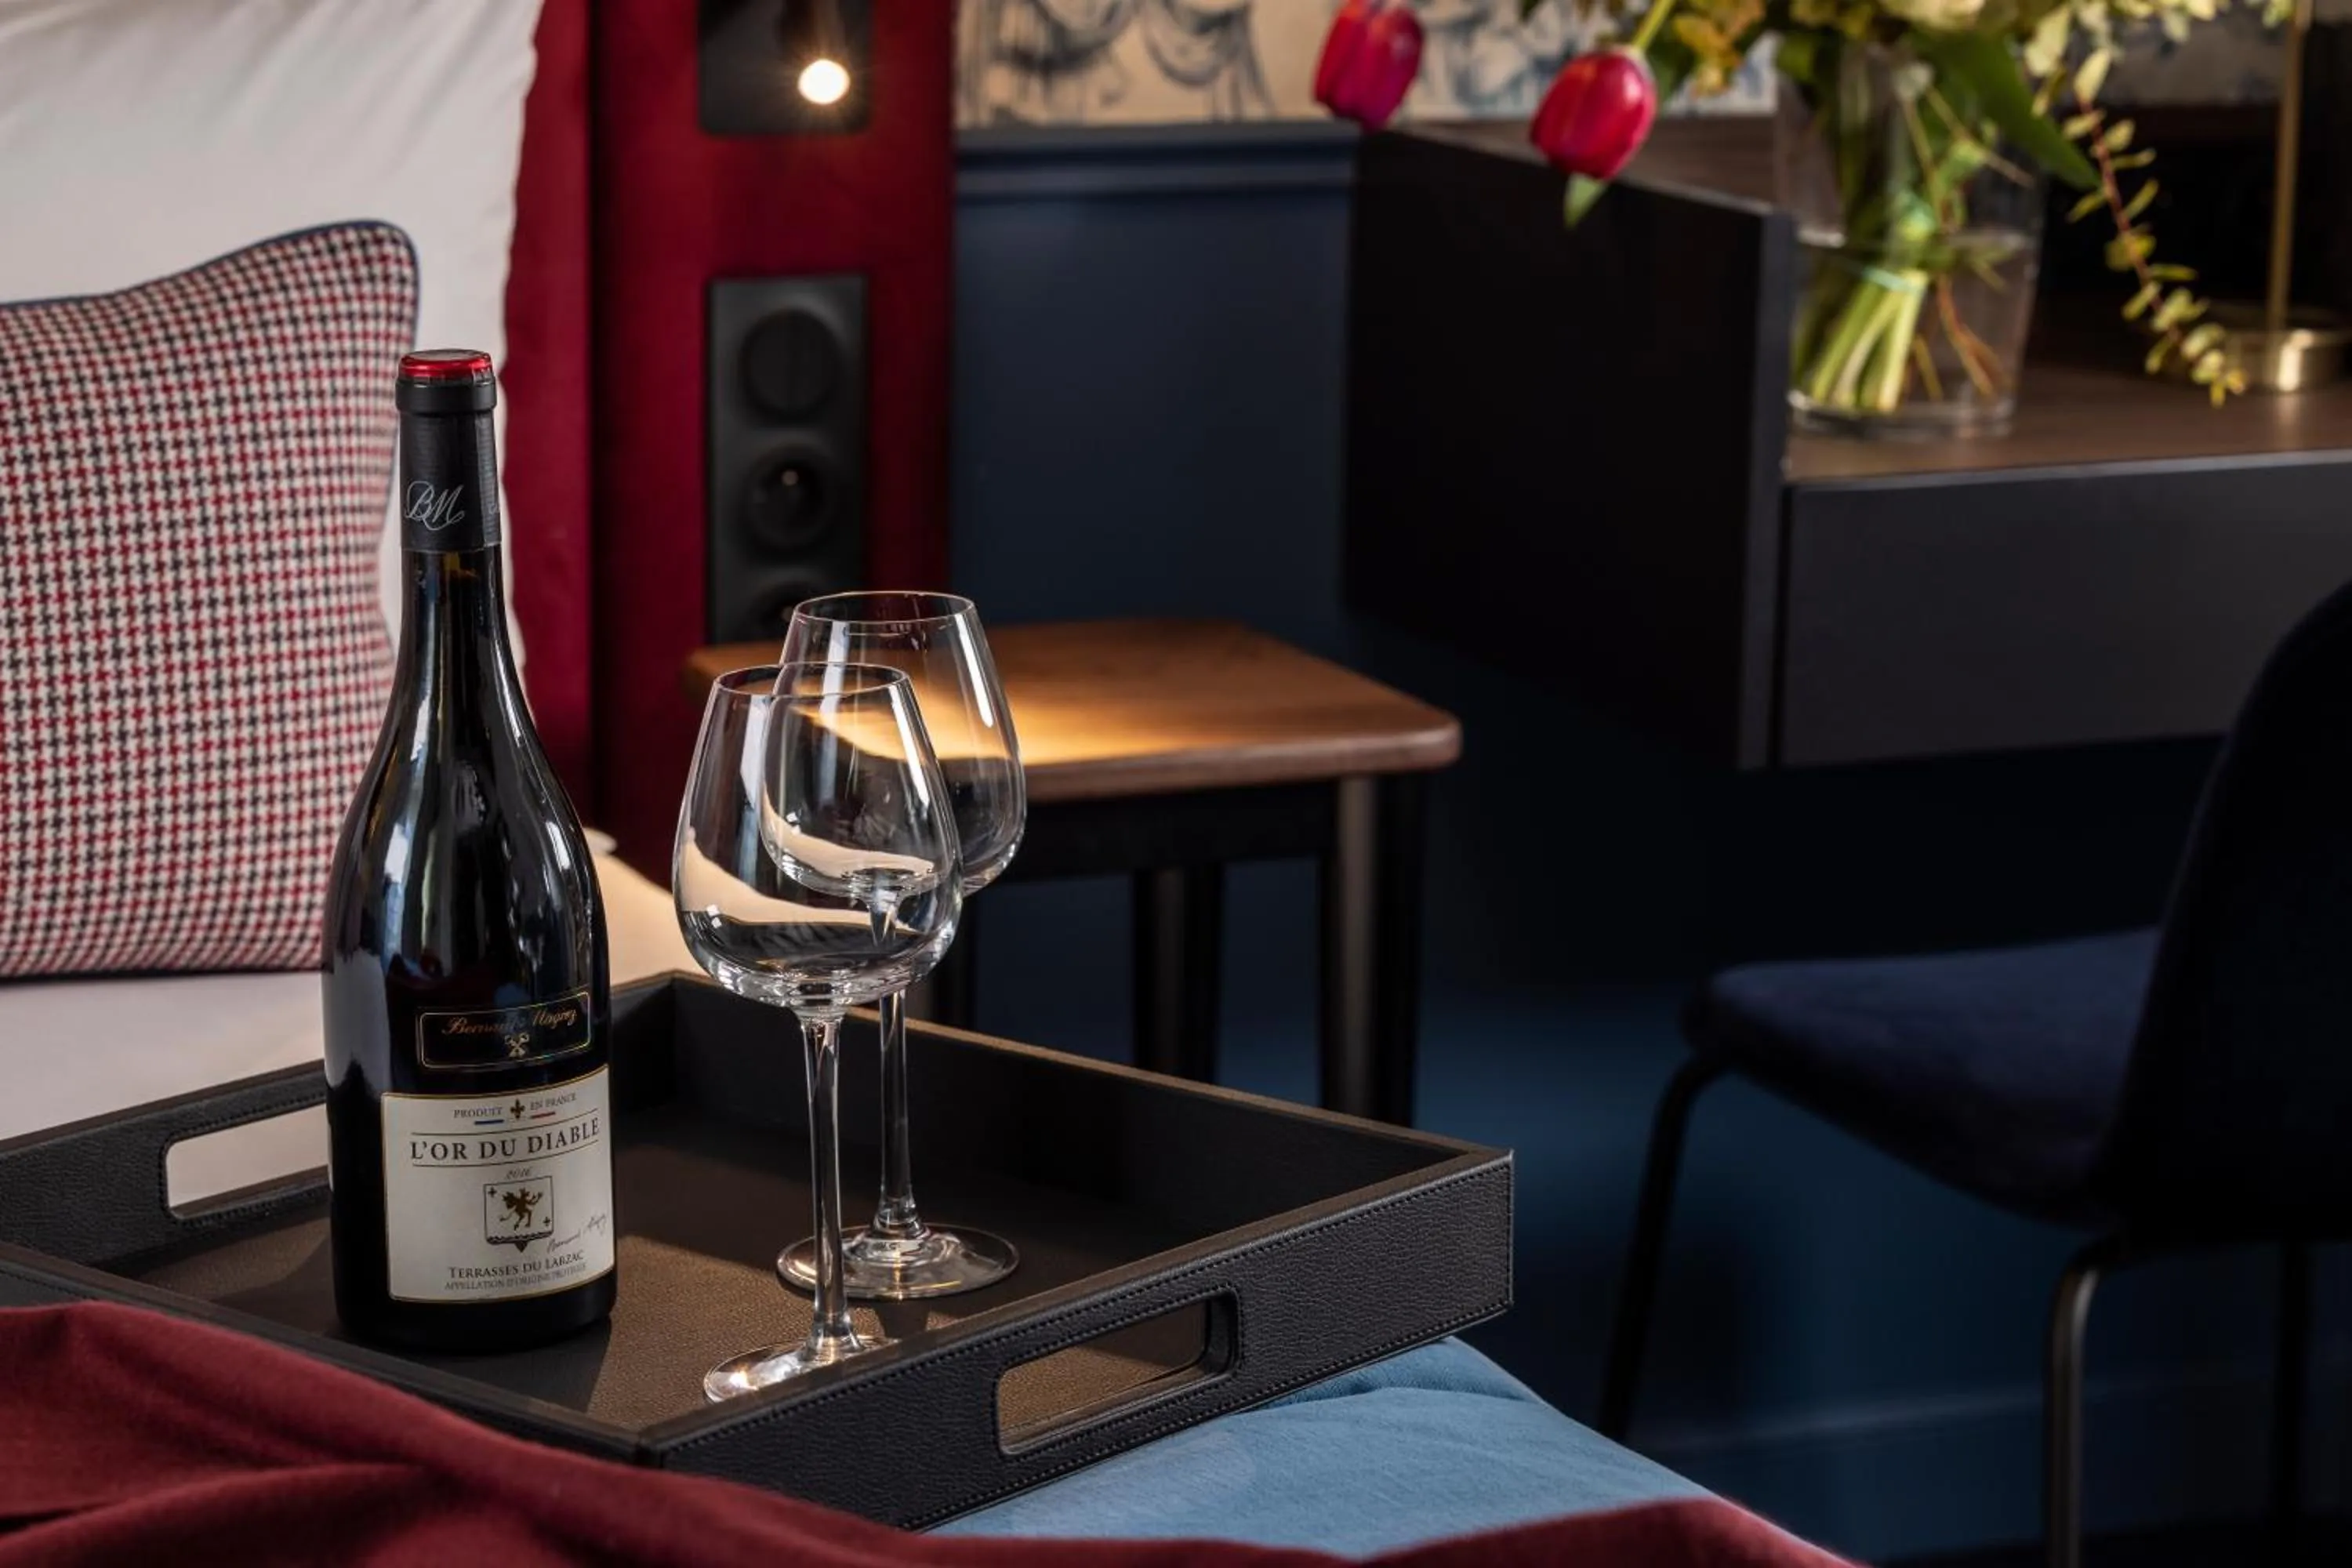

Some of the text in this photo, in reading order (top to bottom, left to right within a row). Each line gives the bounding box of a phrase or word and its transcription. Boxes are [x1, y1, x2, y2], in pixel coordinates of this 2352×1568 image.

[454, 1092, 577, 1119] PRODUIT EN FRANCE
[410, 1117, 601, 1160] L'OR DU DIABLE
[448, 1250, 584, 1279] TERRASSES DU LARZAC
